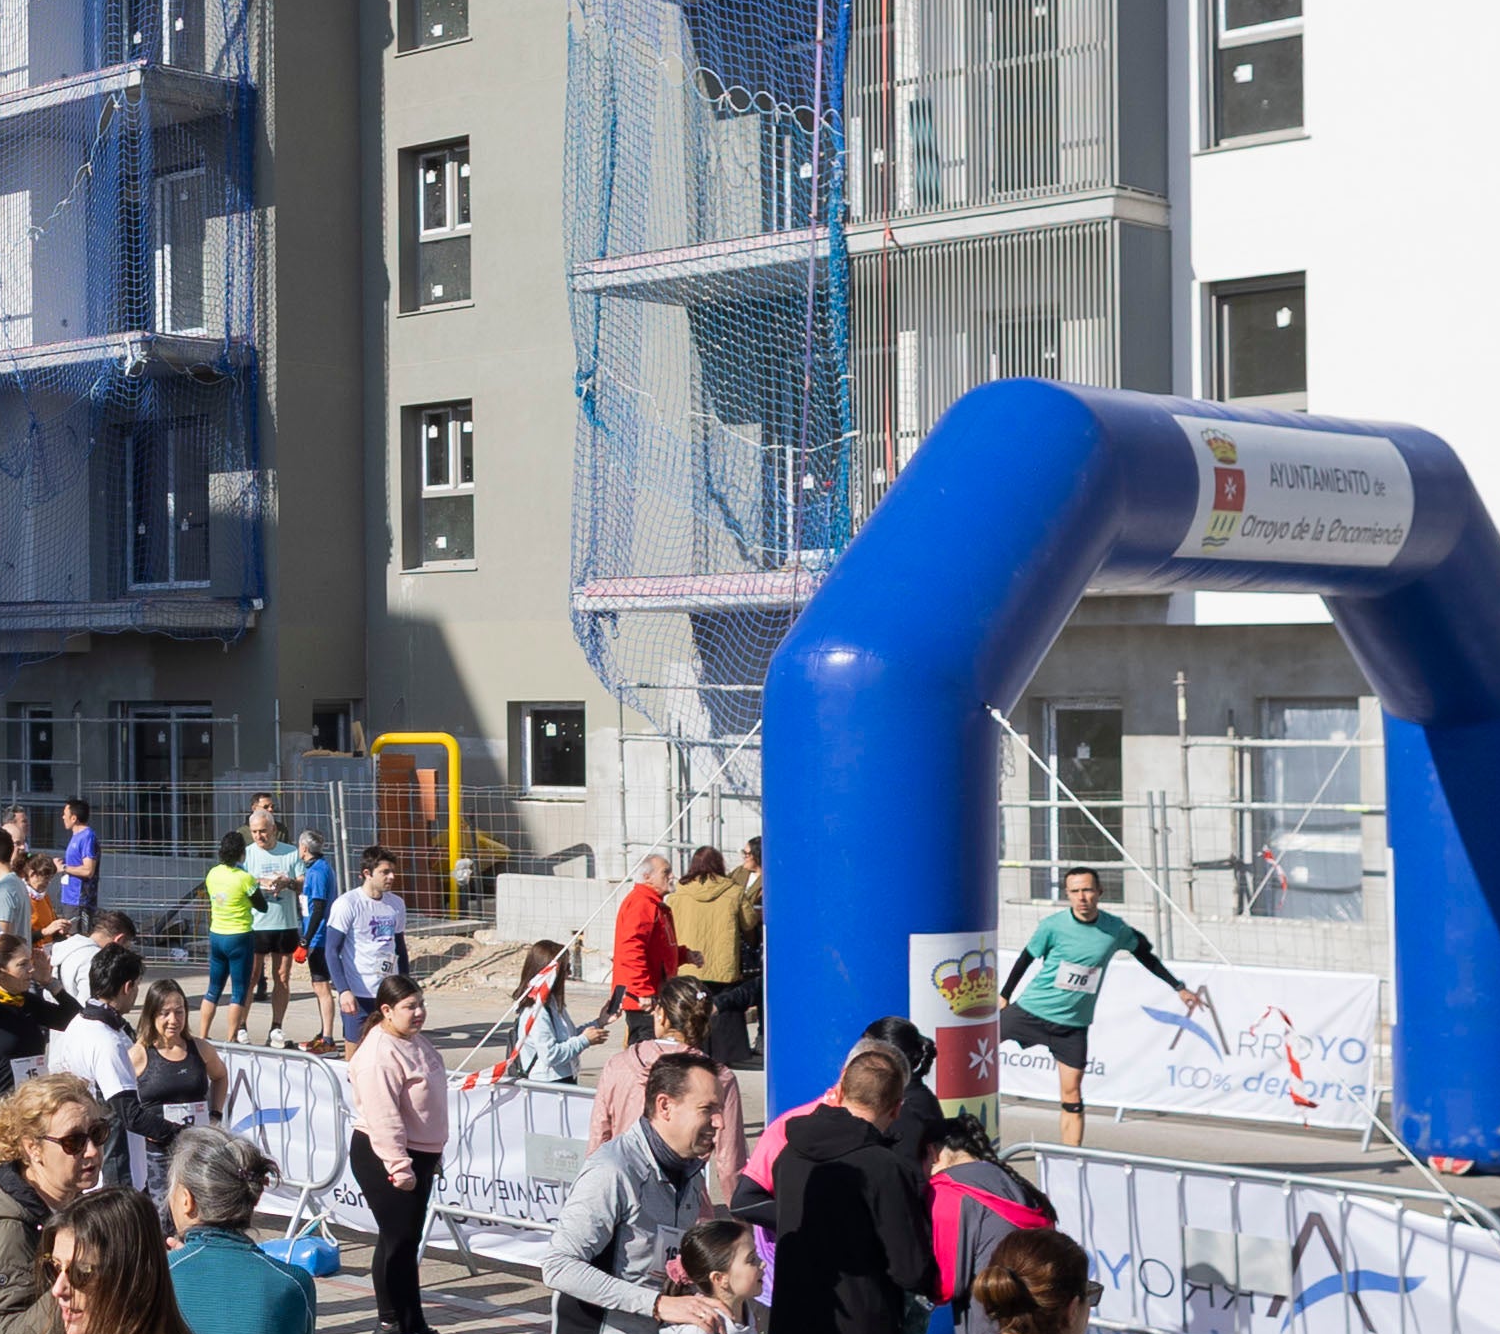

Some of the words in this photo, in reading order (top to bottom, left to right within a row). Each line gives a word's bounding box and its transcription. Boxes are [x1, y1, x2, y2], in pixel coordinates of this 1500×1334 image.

[1270, 462, 1370, 496] AYUNTAMIENTO
[1375, 479, 1386, 497] de
[1241, 515, 1289, 545] Arroyo
[1290, 518, 1309, 541] de
[1311, 518, 1324, 542] la
[1327, 517, 1404, 546] Encomienda
[1068, 972, 1088, 986] 776
[1166, 1065, 1231, 1093] 100%
[1243, 1069, 1366, 1103] deporte
